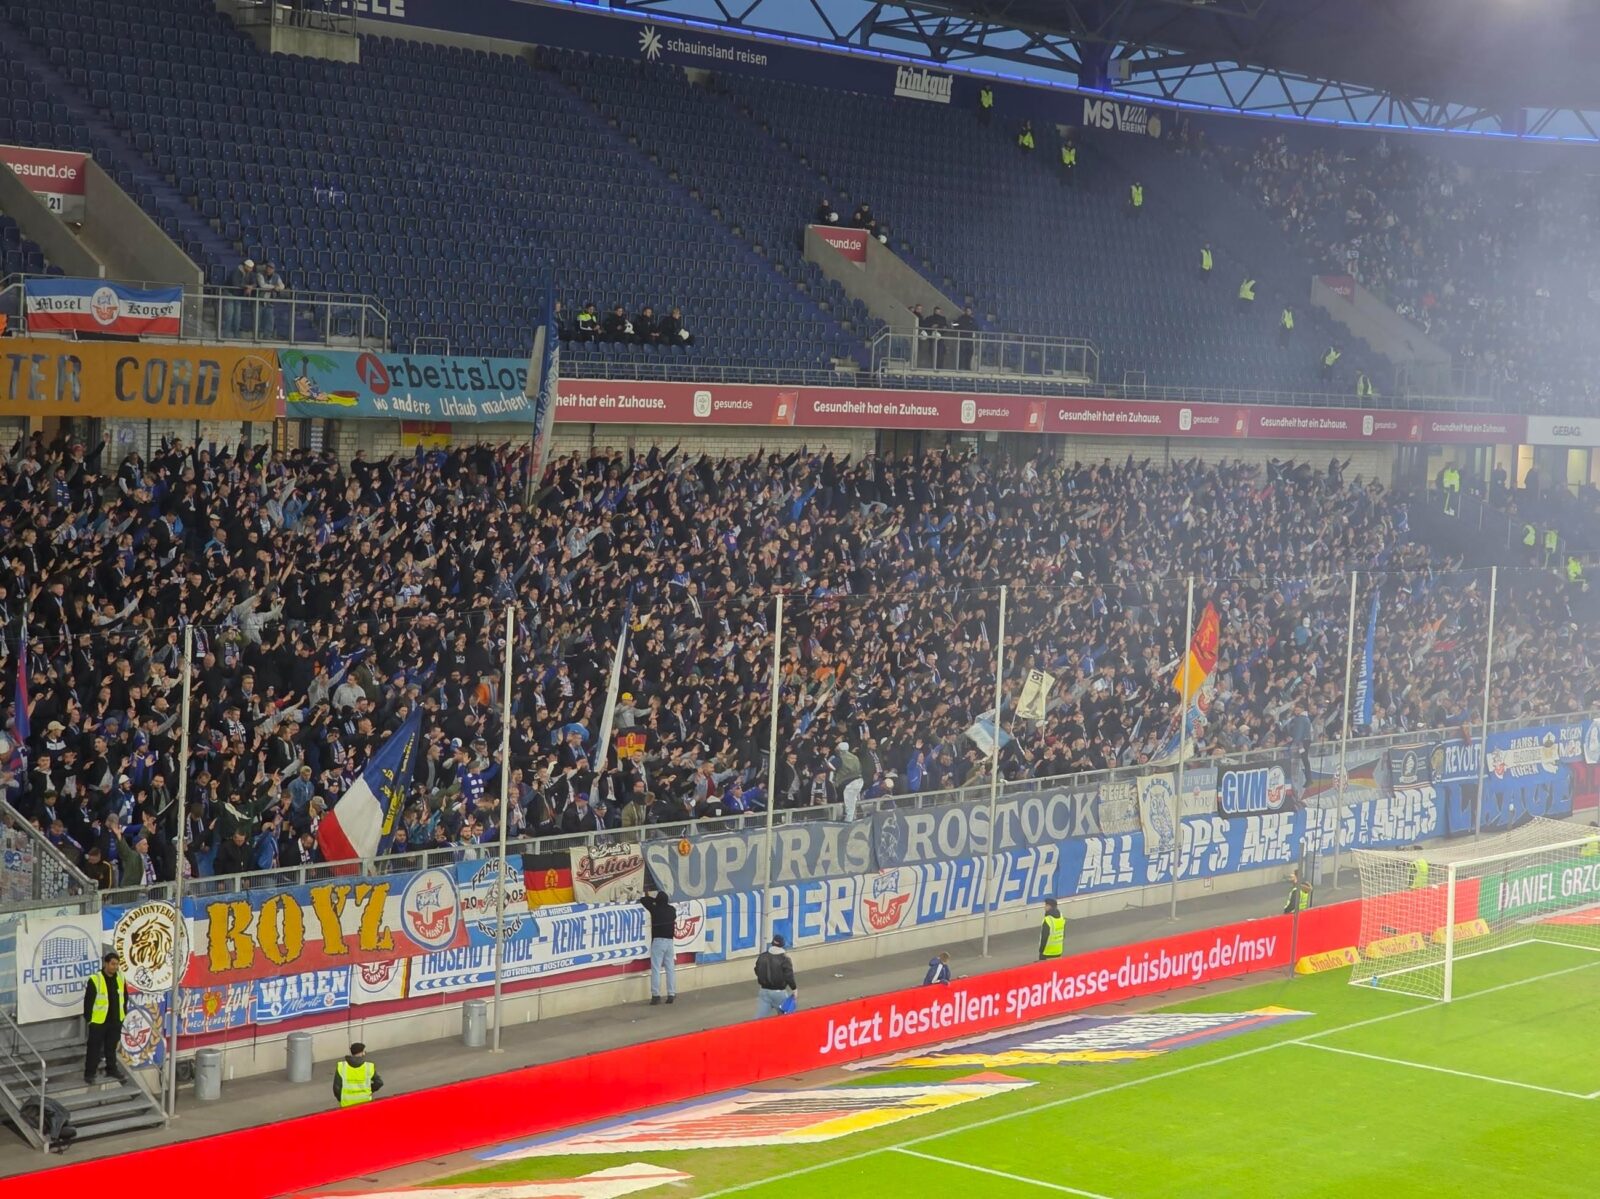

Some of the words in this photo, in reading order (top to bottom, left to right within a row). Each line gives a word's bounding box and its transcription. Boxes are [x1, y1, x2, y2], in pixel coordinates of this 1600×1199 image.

[667, 38, 734, 61] schauinsland
[736, 49, 768, 65] reisen
[895, 66, 953, 98] trinkgut
[50, 197, 61, 210] 21
[34, 297, 81, 312] Mosel
[392, 392, 431, 415] andere
[439, 397, 477, 417] Urlaub
[482, 391, 531, 415] machen!
[578, 395, 597, 408] hat
[599, 396, 616, 408] ein
[617, 396, 667, 409] Zuhause.
[713, 399, 753, 410] gesund.de
[813, 400, 866, 415] Gesundheit
[867, 401, 882, 415] hat
[883, 402, 898, 415] ein
[899, 403, 939, 416] Zuhause.
[977, 407, 1010, 418] gesund.de
[1058, 409, 1101, 422] Gesundheit
[1102, 411, 1115, 422] hat
[1115, 412, 1127, 423] ein
[1128, 412, 1162, 424] Zuhause.
[1260, 416, 1297, 428] Gesundheit
[1297, 417, 1308, 428] hat
[1308, 418, 1318, 429] ein
[1319, 418, 1348, 430] Zuhause.
[1432, 422, 1462, 433] Gesundheit
[1445, 743, 1483, 775] REVOLT
[1221, 767, 1269, 813] GVM
[902, 792, 1100, 862] ROSTOCK
[646, 818, 872, 898] SUPTRAS
[1076, 834, 1134, 894] ALL
[1237, 811, 1295, 872] ARE
[471, 860, 519, 891] FANAICS
[464, 896, 477, 909] 20
[511, 889, 523, 900] 05
[1498, 872, 1556, 912] DANIEL
[207, 882, 395, 973] BOYZ
[704, 878, 854, 960] SUPER
[485, 937, 534, 967] FINDE
[552, 916, 587, 955] KEINE
[590, 907, 646, 948] FREUNDE
[543, 958, 575, 971] ROSTOCK
[1309, 955, 1343, 972] Sinalco
[259, 970, 347, 1003] WAREN
[820, 1016, 882, 1055] Jetzt
[890, 990, 1001, 1038] bestellen:
[1005, 934, 1277, 1019] sparkasse-duisburg.de/msv
